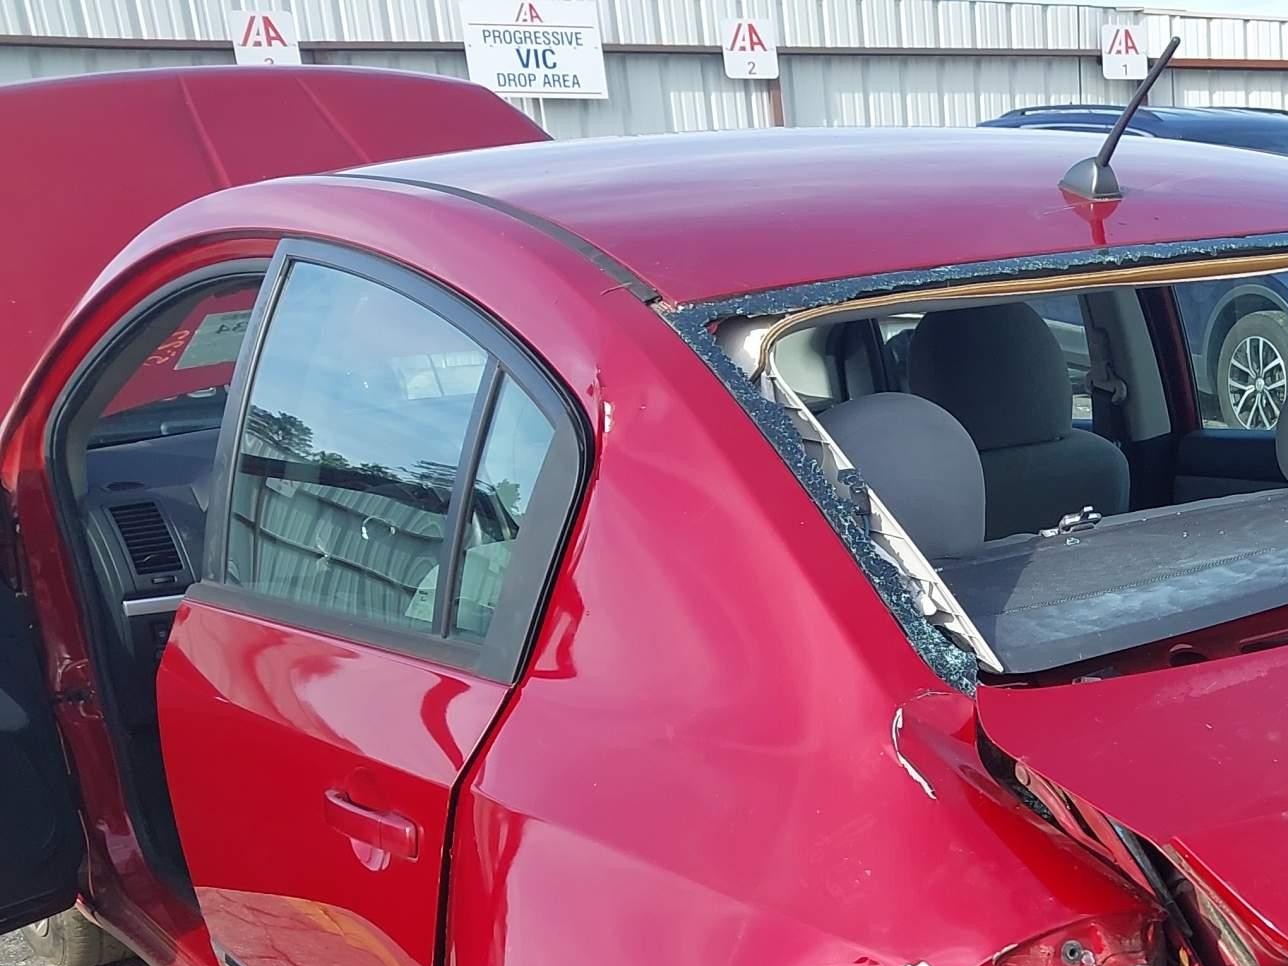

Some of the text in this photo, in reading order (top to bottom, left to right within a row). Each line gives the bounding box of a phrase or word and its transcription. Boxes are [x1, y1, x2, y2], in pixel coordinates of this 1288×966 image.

[482, 29, 583, 46] PROGRESSIVE
[515, 48, 557, 69] VIC
[747, 61, 757, 75] 2
[1121, 63, 1128, 76] 1
[496, 72, 581, 88] DROP AREA
